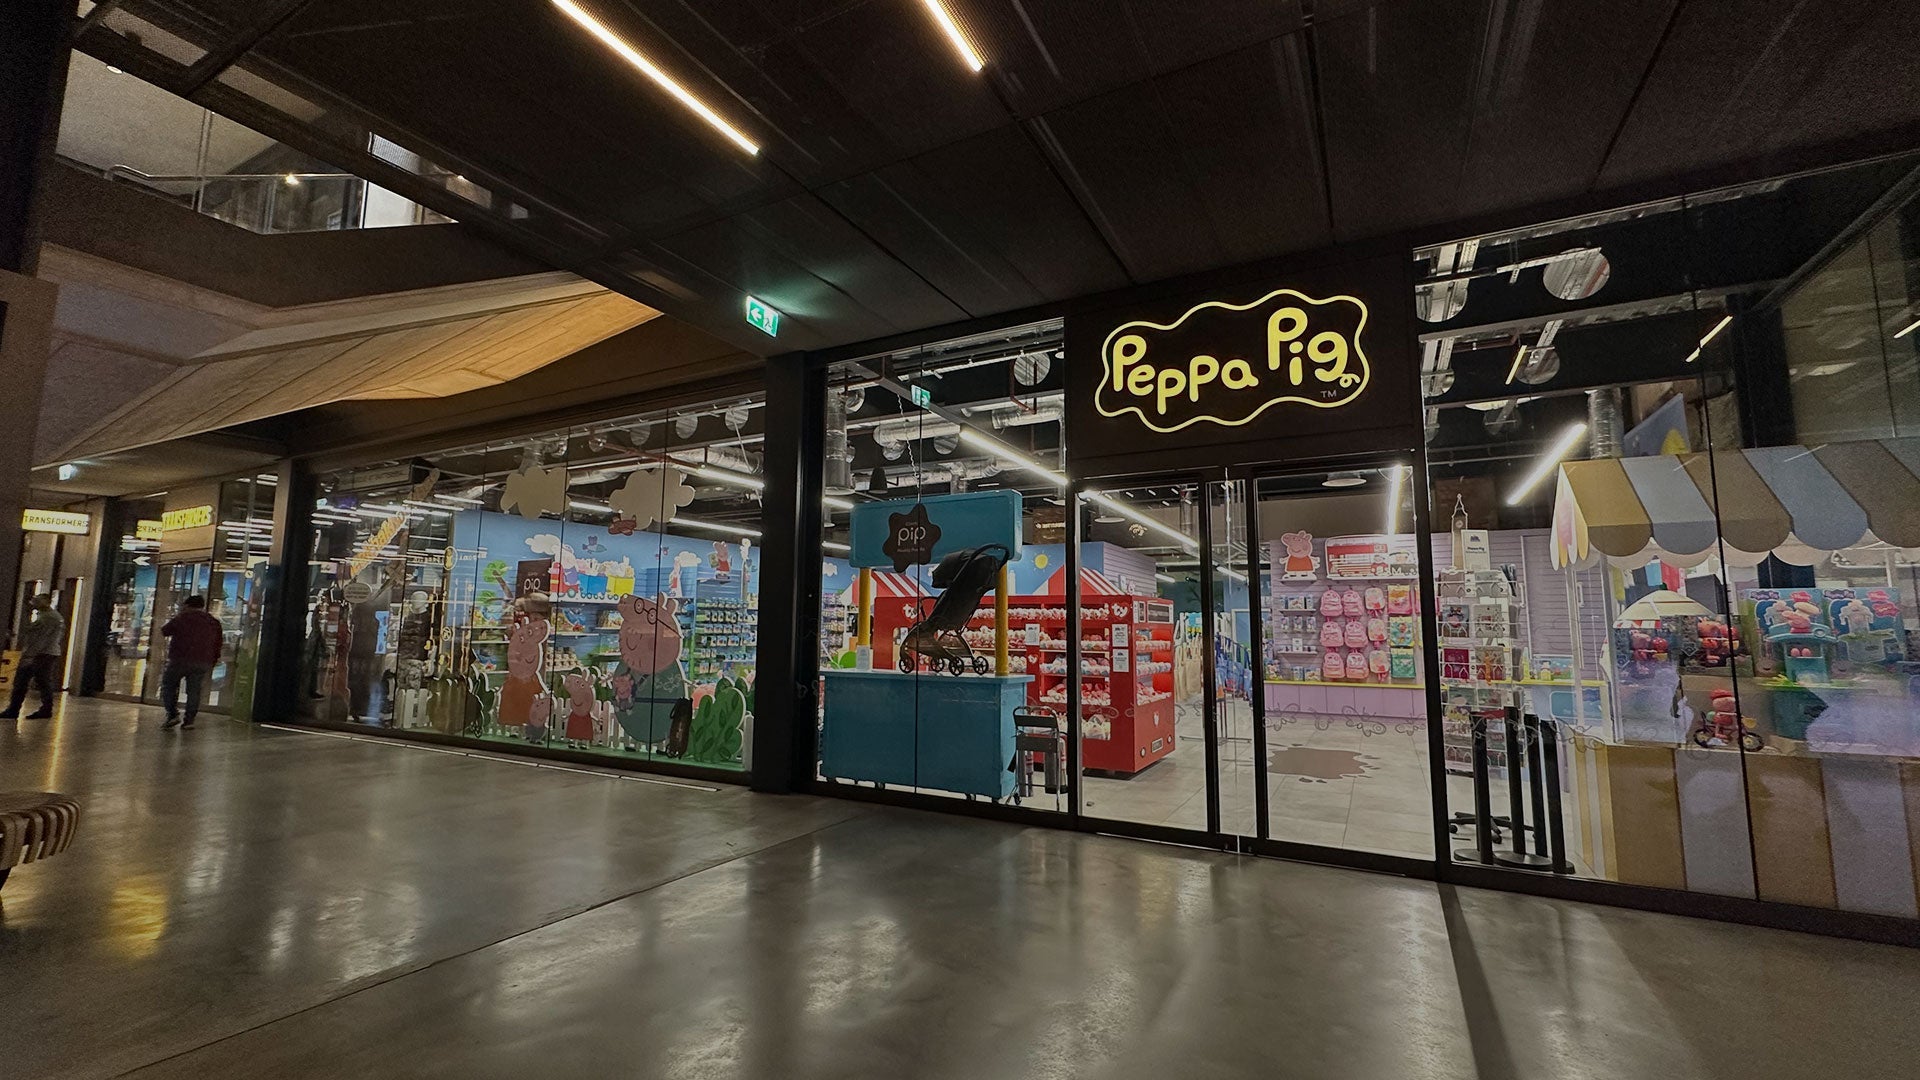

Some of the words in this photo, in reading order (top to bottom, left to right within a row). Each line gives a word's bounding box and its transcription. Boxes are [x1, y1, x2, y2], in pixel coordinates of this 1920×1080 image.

[1113, 335, 1259, 415] Peppa
[1267, 307, 1358, 388] Pig
[1320, 390, 1337, 398] TM
[23, 515, 90, 527] TRANSFORMERS
[897, 525, 926, 546] pip
[523, 578, 541, 595] pip
[1111, 602, 1129, 618] ty
